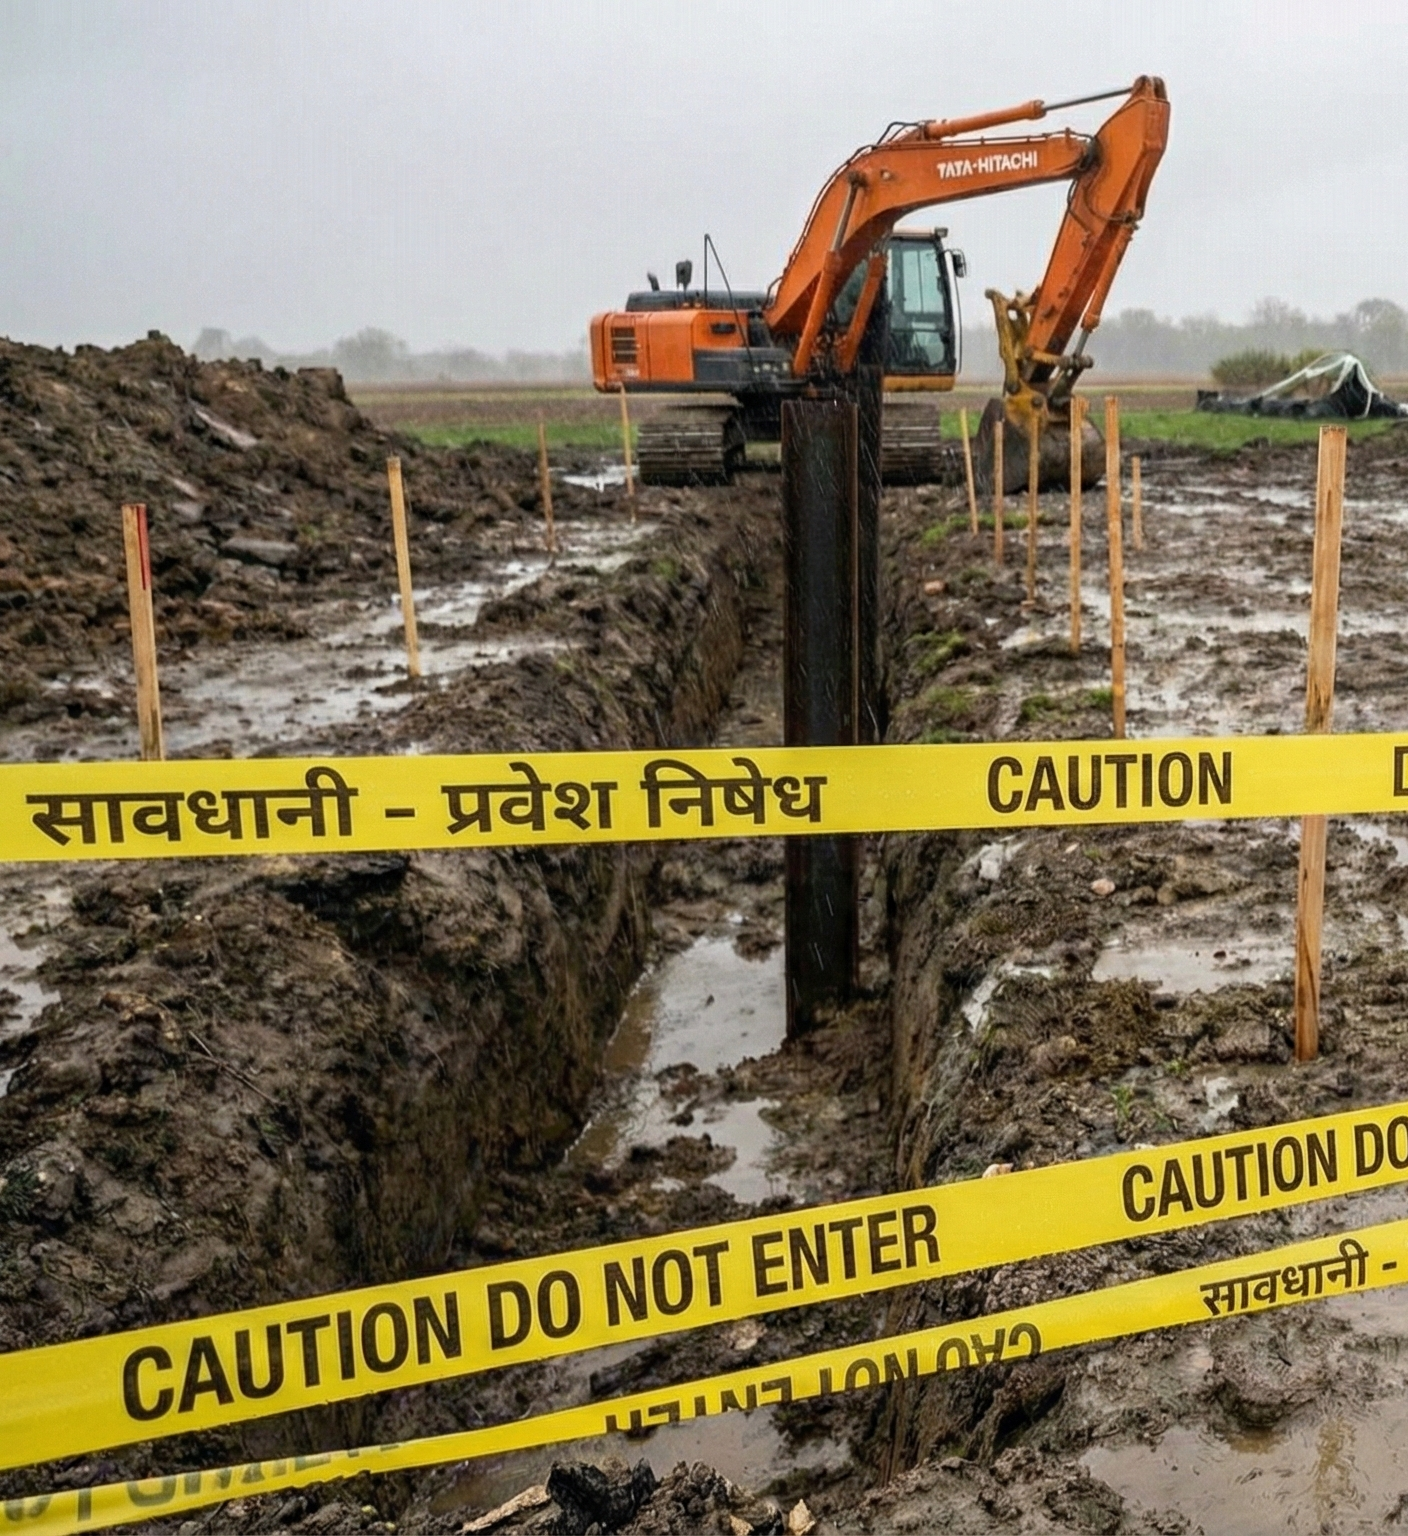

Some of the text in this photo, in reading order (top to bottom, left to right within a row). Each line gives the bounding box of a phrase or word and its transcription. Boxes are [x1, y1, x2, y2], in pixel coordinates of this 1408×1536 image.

[25, 766, 358, 847] सावधानी
[442, 762, 617, 834] प्रवेश
[640, 758, 827, 827] निषेध
[988, 752, 1231, 813] CAUTION
[122, 1291, 463, 1421] CAUTION
[487, 1270, 582, 1350] DO
[603, 1240, 730, 1326] NOT
[751, 1204, 940, 1297] ENTER
[1122, 1130, 1338, 1222] CAUTION
[1200, 1239, 1370, 1316] सावधानी
